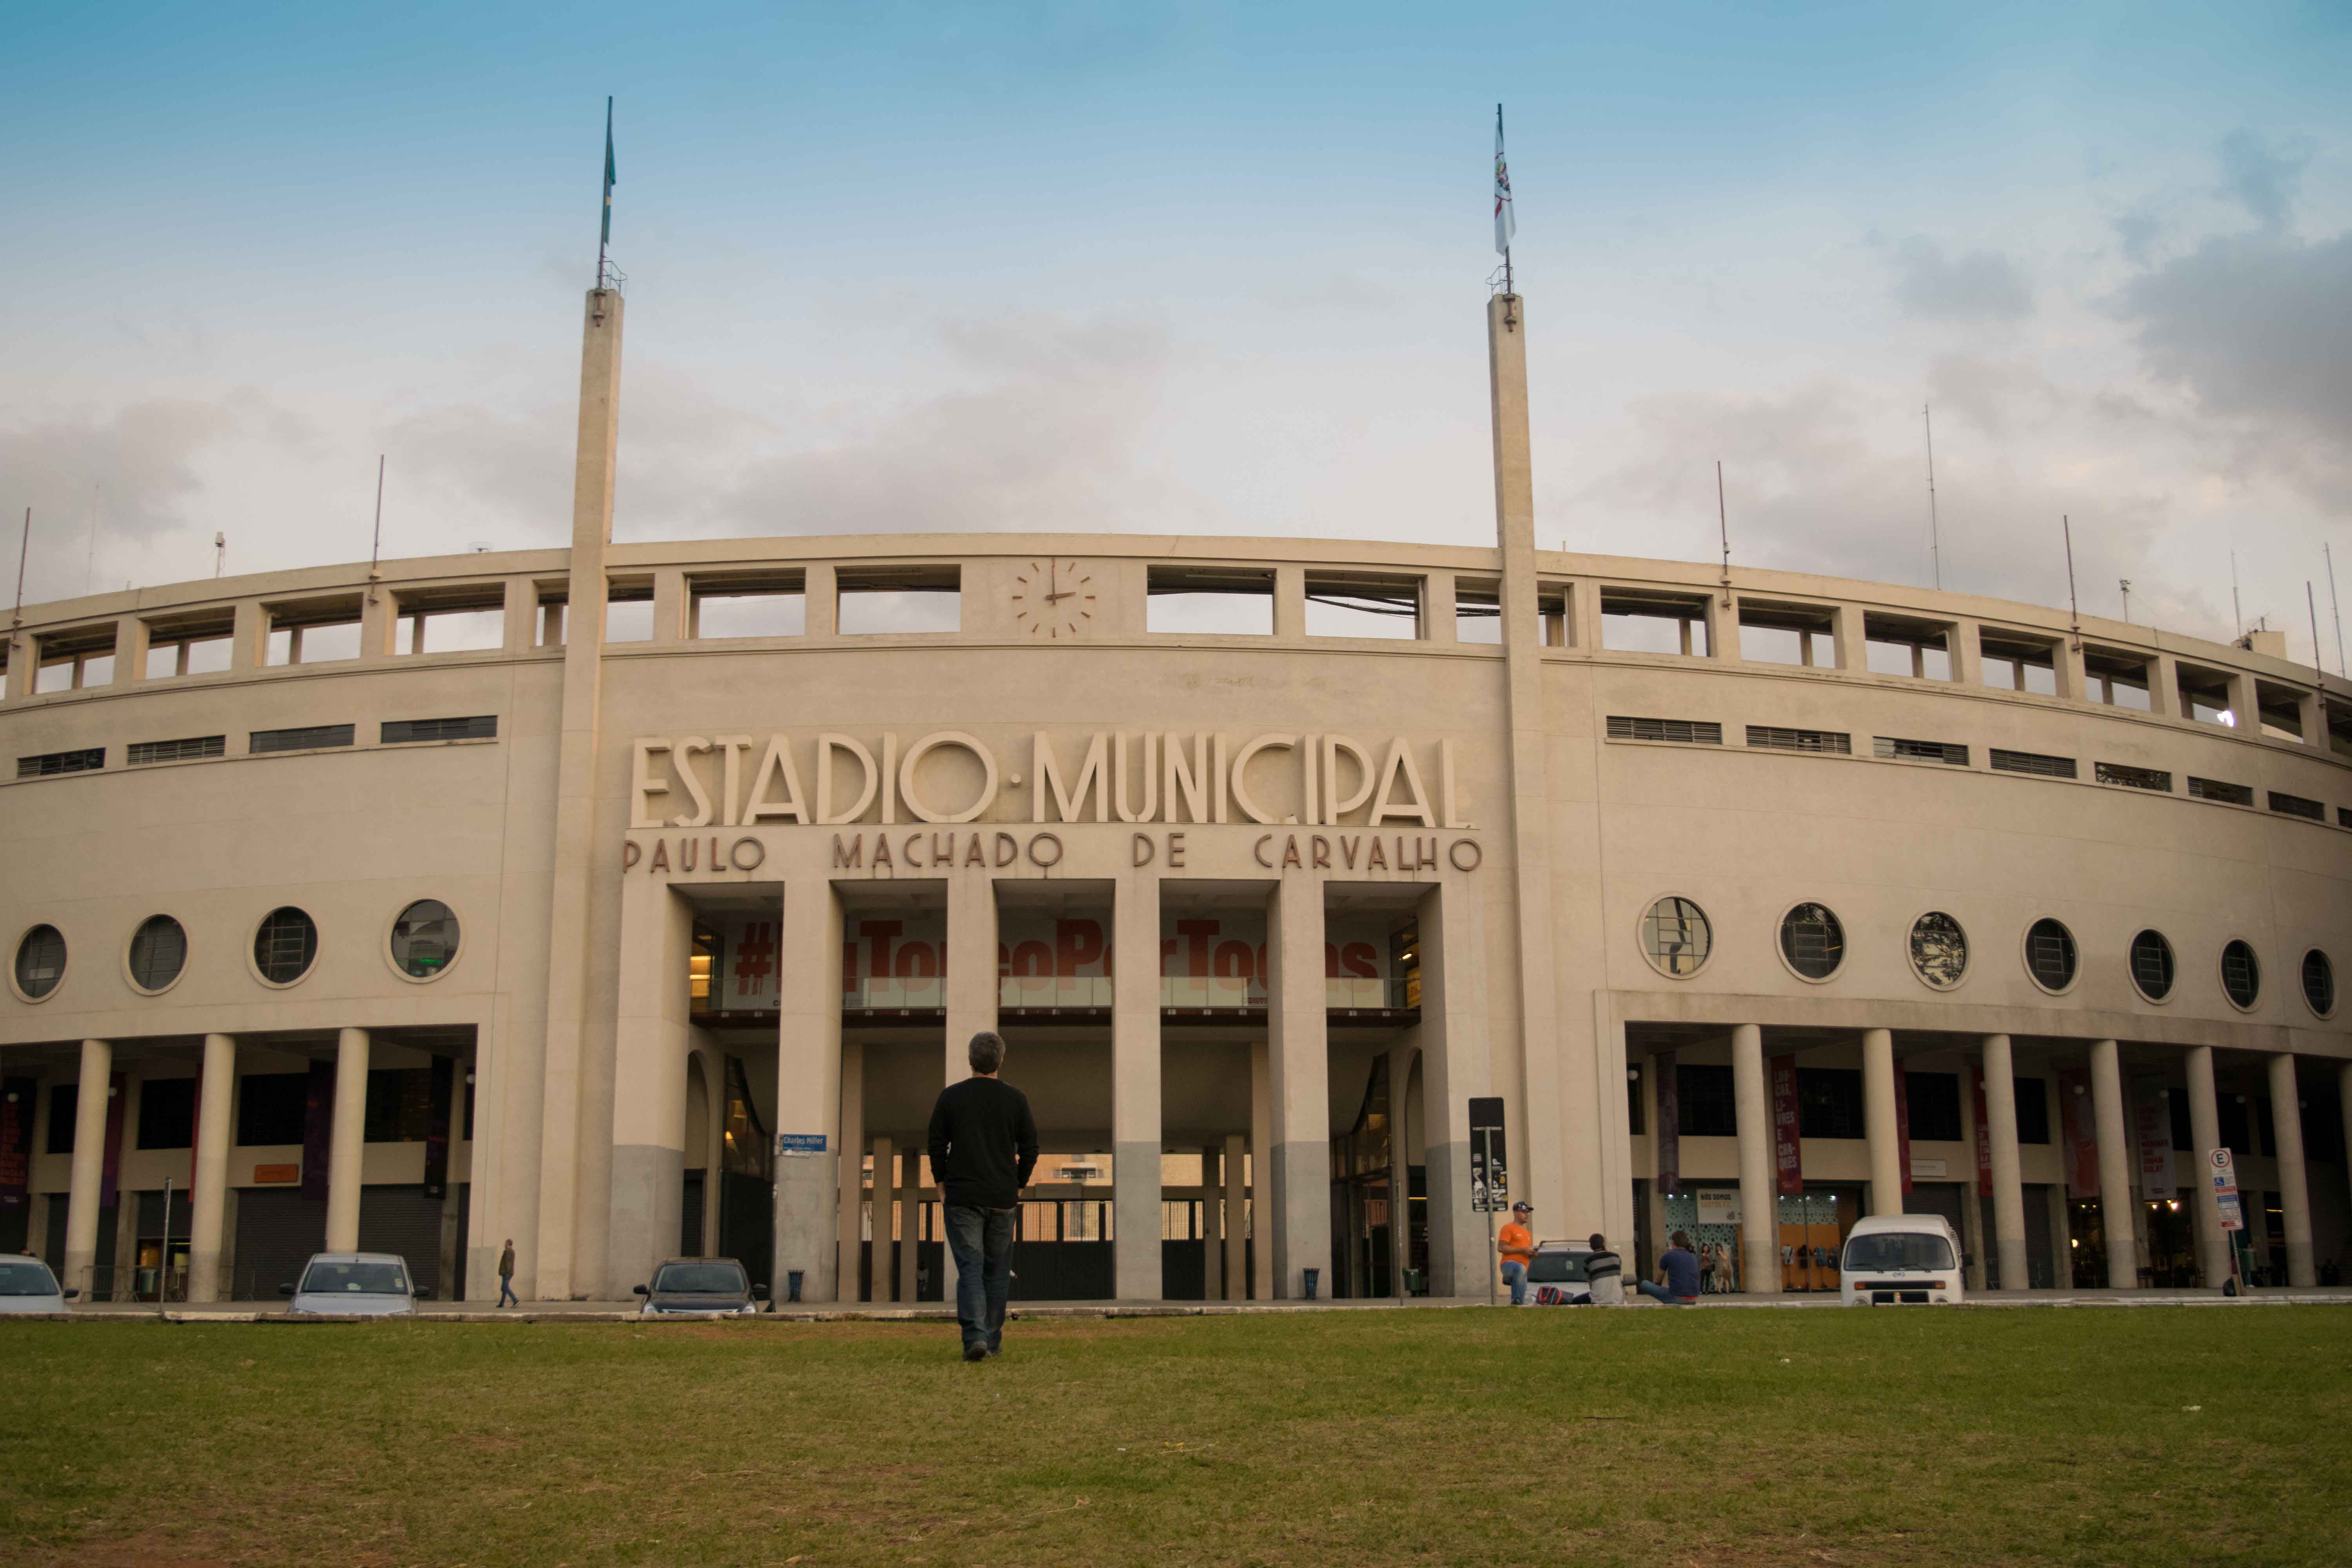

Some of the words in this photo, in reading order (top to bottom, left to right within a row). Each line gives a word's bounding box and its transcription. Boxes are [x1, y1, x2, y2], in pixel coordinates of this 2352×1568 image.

[630, 730, 998, 827] ESTADIO
[1033, 730, 1475, 828] MUNICIPAL
[623, 836, 765, 873] PAULO
[833, 832, 1063, 868] MACHADO
[1133, 832, 1185, 867] DE
[1255, 833, 1483, 871] CARVALHO
[784, 1136, 805, 1145] Charles
[1777, 1129, 1782, 1141] E
[2216, 1153, 2225, 1164] E
